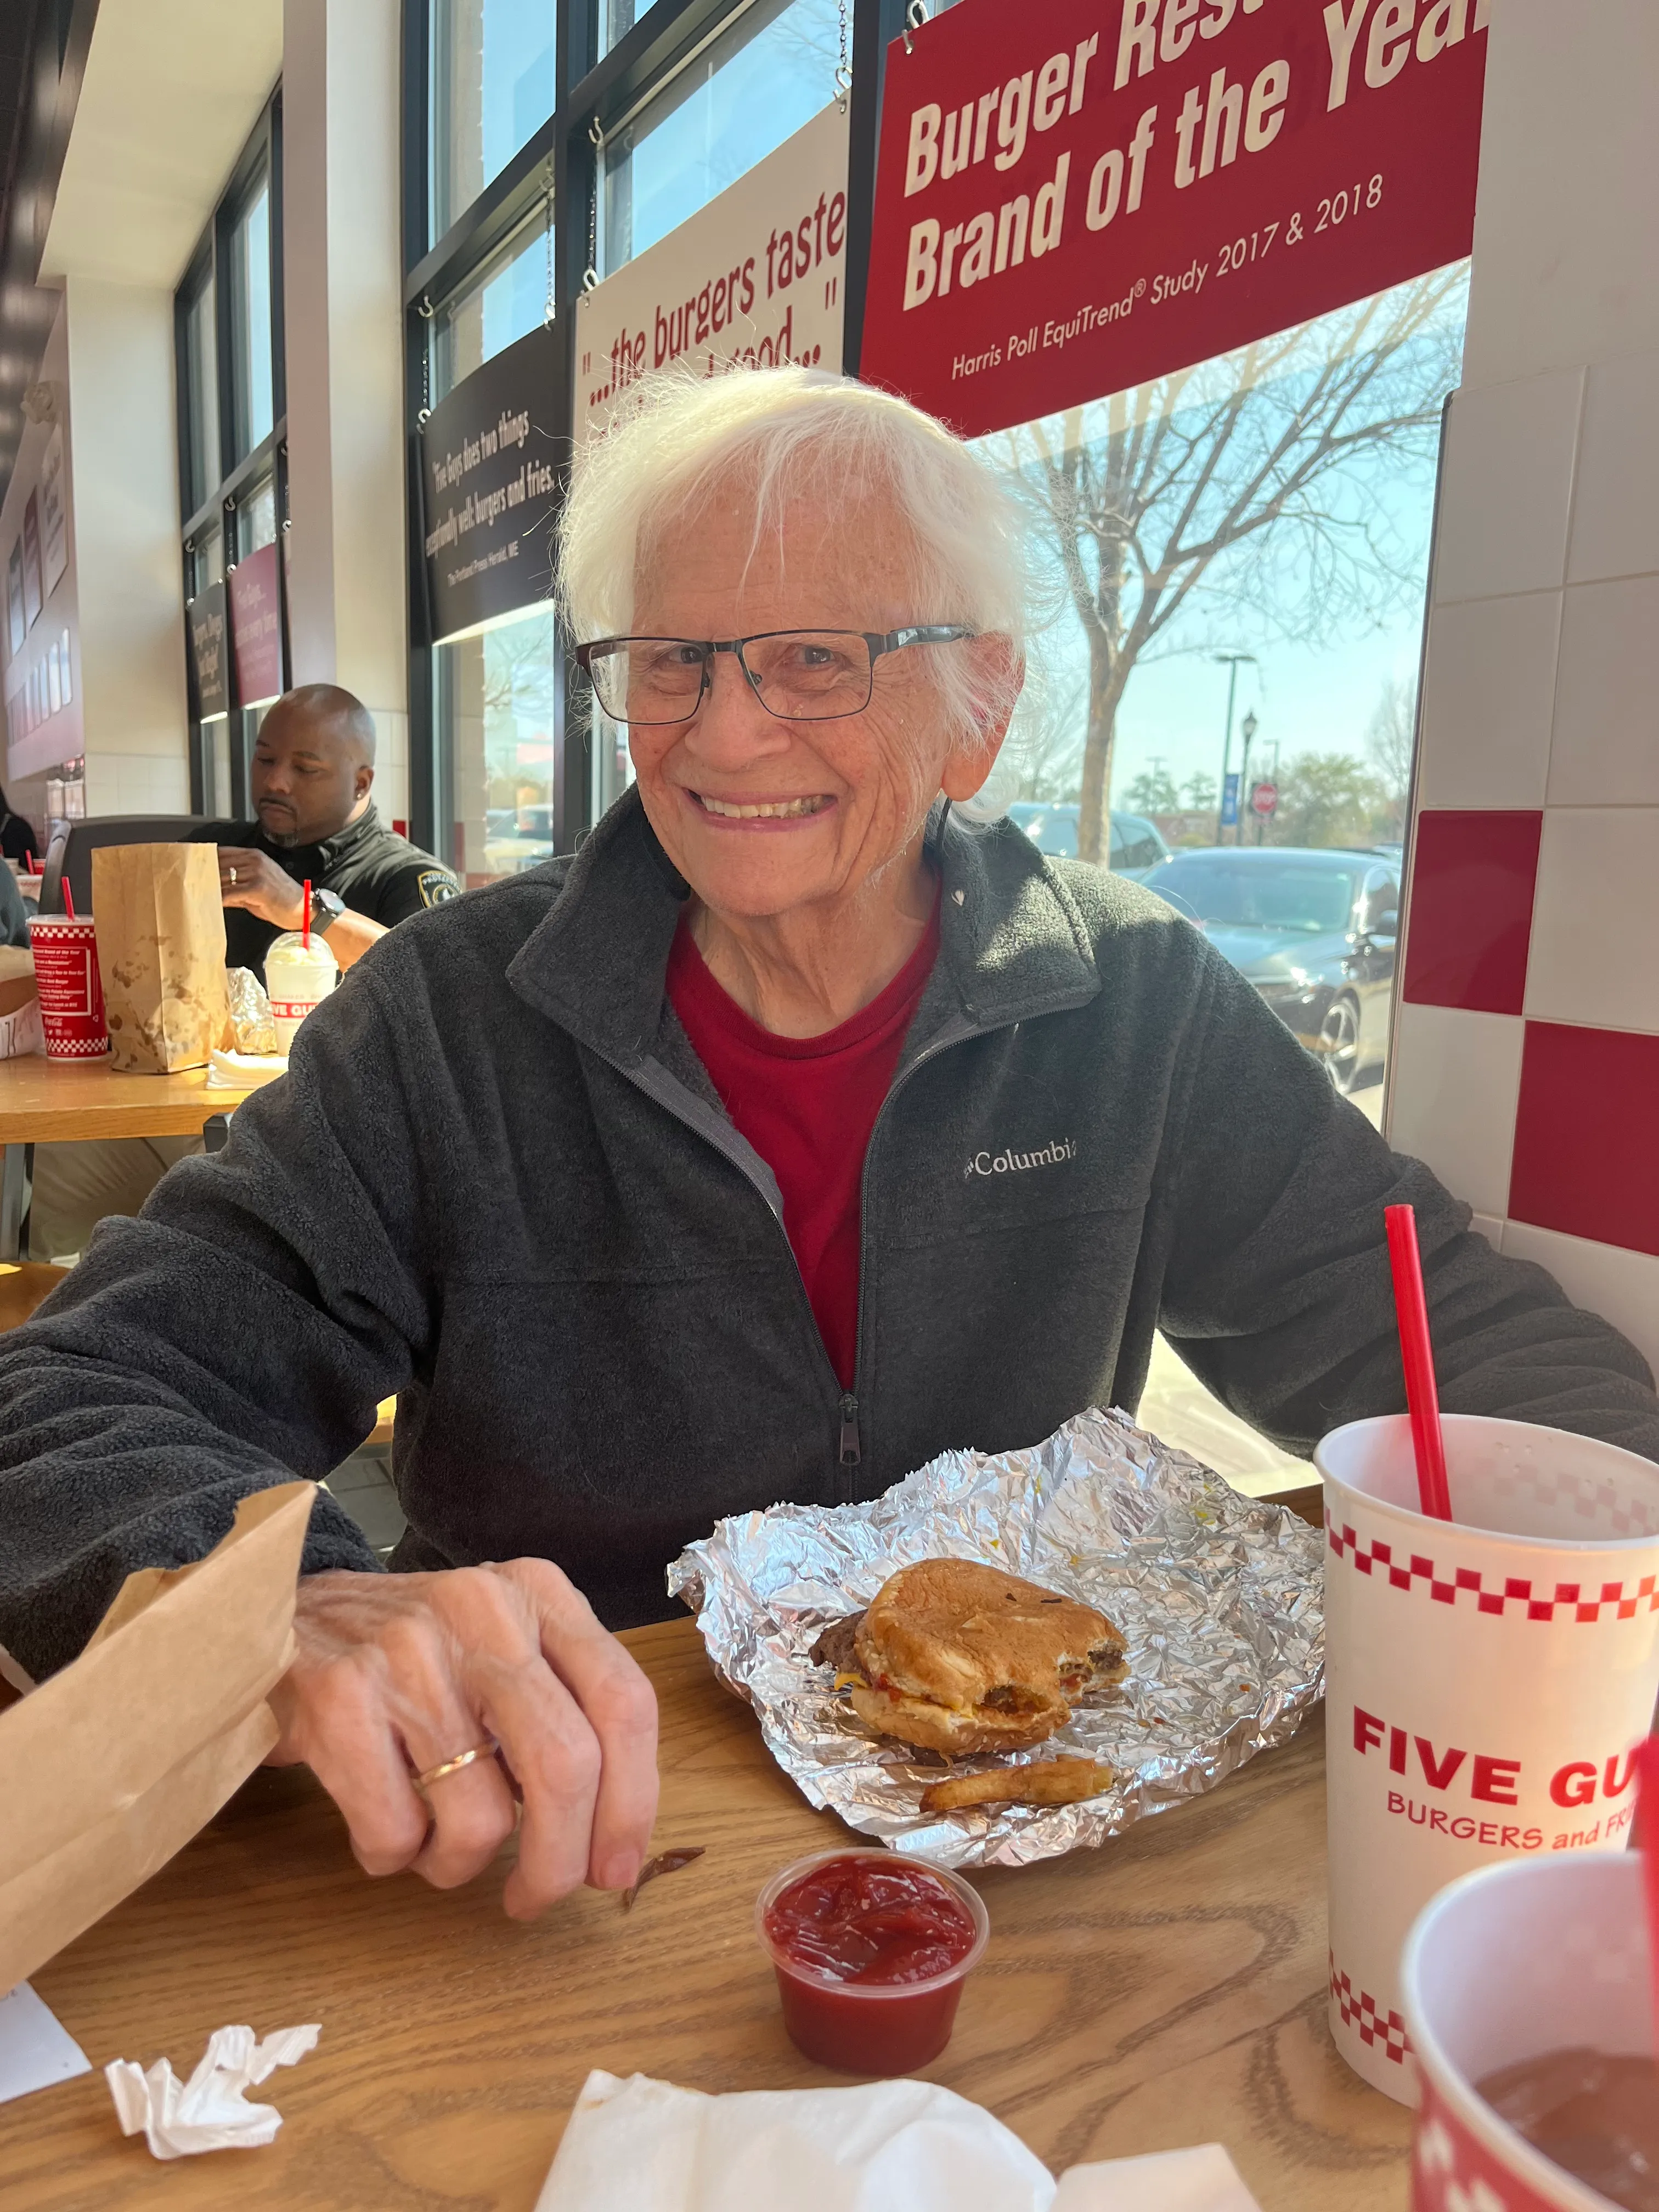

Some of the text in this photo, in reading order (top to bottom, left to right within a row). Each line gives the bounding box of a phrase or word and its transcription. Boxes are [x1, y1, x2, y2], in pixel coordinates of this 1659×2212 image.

[904, 0, 1263, 198] Burger Res
[903, 150, 1071, 312] Brand
[1085, 105, 1158, 232] of
[1175, 59, 1290, 189] the
[654, 257, 755, 369] burgers
[766, 191, 845, 299] taste
[952, 344, 1002, 380] Harris
[1007, 326, 1039, 361] Poll
[1150, 259, 1209, 304] Study
[1216, 221, 1280, 278] 2017
[1285, 212, 1304, 246] &
[1313, 173, 1383, 234] 2018
[462, 437, 481, 472] does
[481, 431, 498, 460] two
[498, 409, 530, 449] things
[474, 490, 506, 527] burgers
[506, 465, 526, 508] and
[1353, 1705, 1521, 1806] FIVE
[1387, 1790, 1543, 1850] BURGERS
[1551, 1820, 1600, 1850] and
